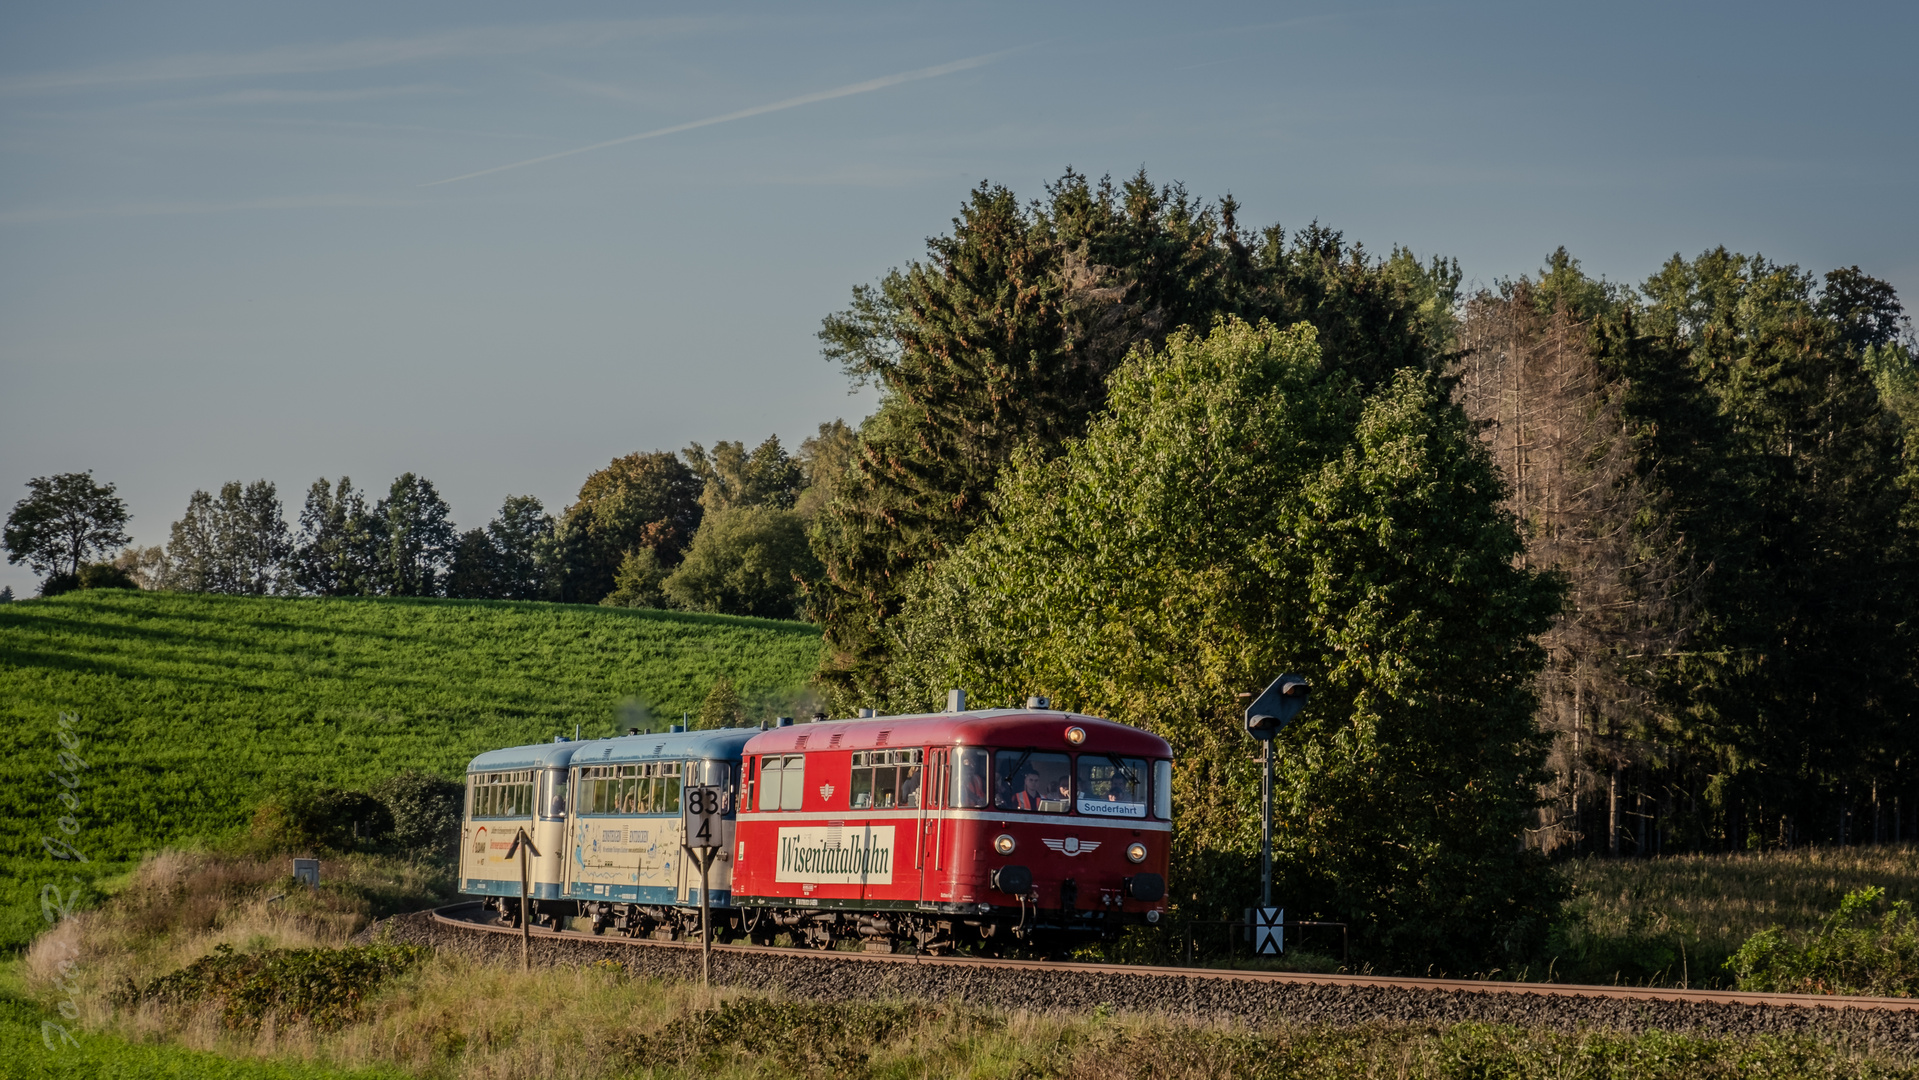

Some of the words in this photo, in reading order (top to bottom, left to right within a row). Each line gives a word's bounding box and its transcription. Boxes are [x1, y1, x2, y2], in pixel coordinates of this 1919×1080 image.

[689, 791, 718, 815] 83
[1084, 803, 1137, 814] Sonderfahrt
[695, 818, 712, 842] 4
[781, 834, 889, 874] Wisentatalbahn
